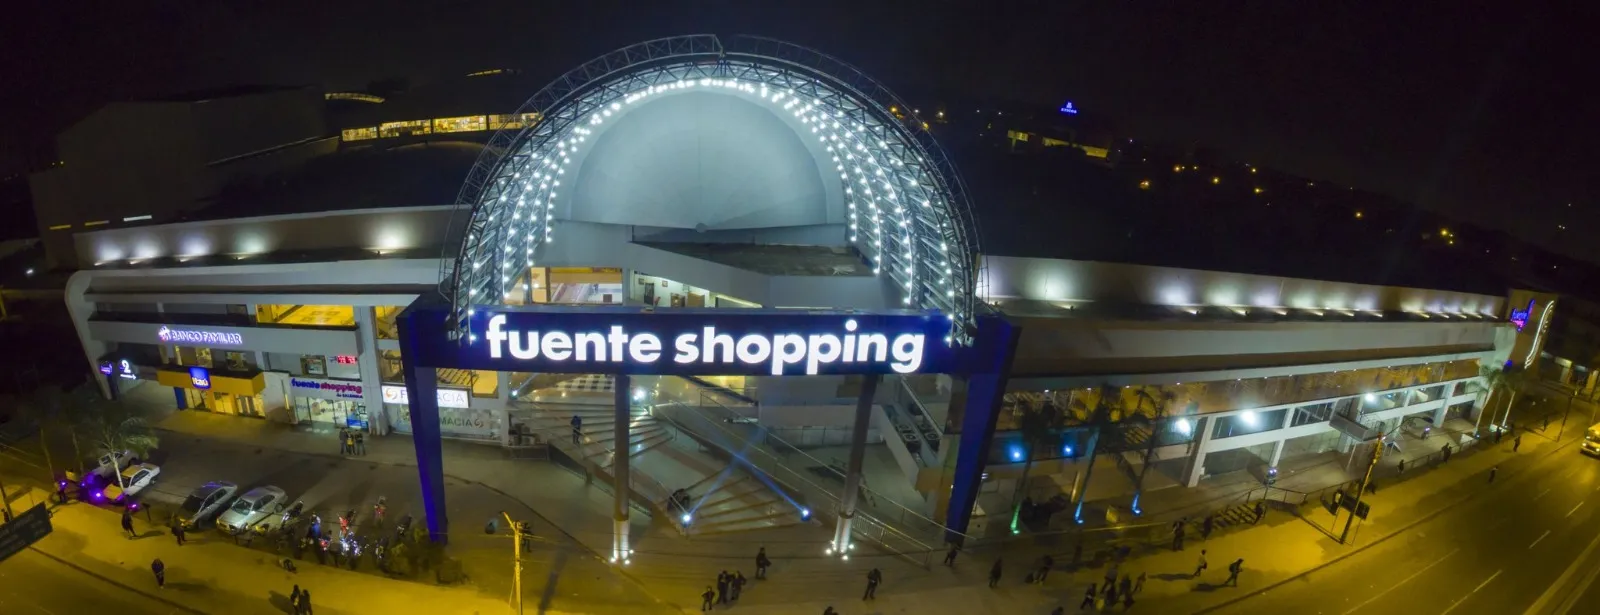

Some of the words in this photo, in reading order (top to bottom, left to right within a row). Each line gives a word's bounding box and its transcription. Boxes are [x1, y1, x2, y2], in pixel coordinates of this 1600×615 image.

[171, 329, 203, 342] BANCO
[203, 331, 243, 344] FAMILIAR
[486, 315, 661, 362] fuente
[675, 319, 925, 375] shopping
[291, 378, 320, 389] fuente
[320, 382, 362, 394] shopping
